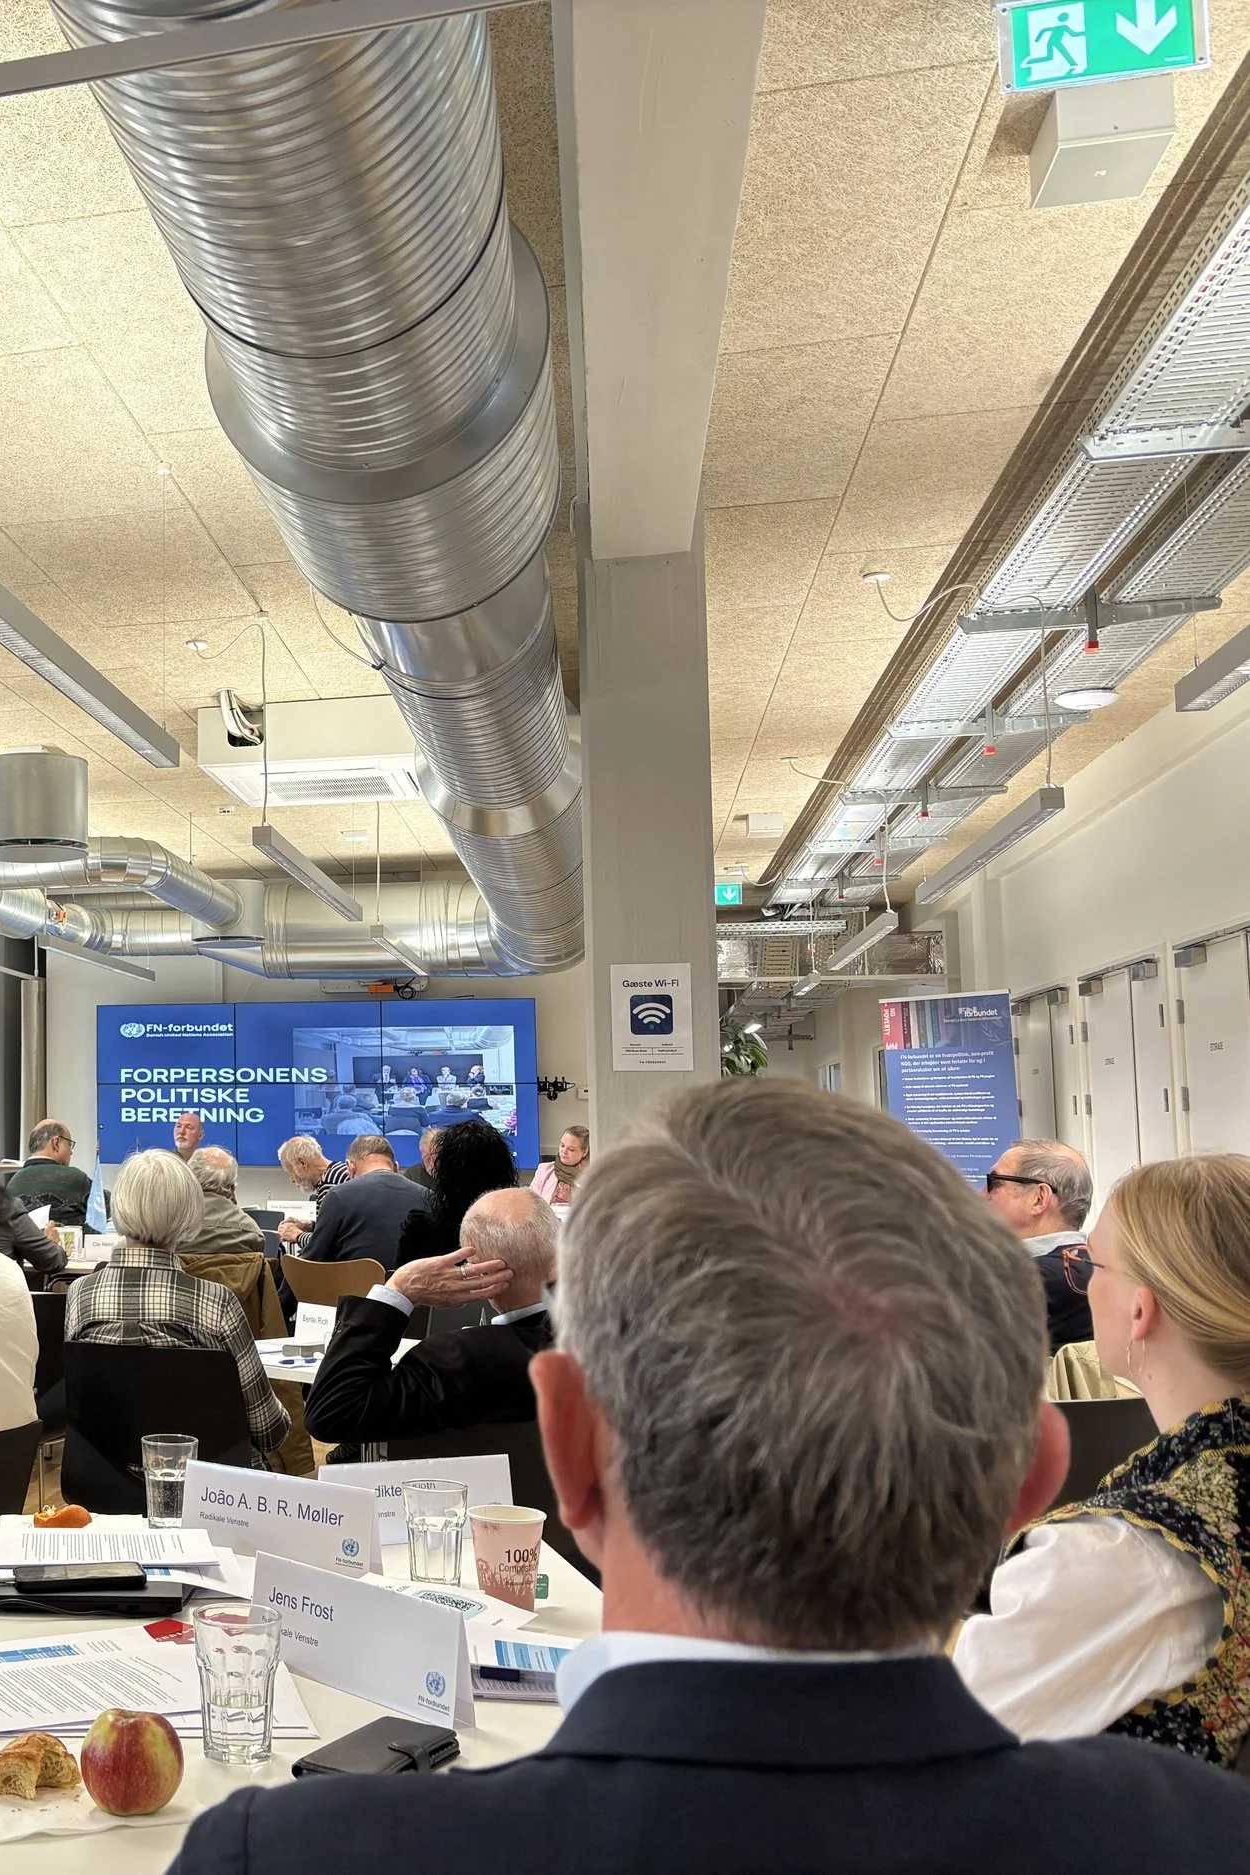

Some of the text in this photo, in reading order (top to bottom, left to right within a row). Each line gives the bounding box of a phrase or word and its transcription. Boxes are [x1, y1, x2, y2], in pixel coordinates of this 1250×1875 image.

[622, 979, 679, 988] Gæste Wi-Fi
[964, 1008, 998, 1017] forbundet
[146, 1023, 234, 1032] FN-forbundet
[120, 1067, 328, 1083] FORPERSONENS
[121, 1088, 250, 1103] POLITISKE
[302, 1314, 317, 1324] Bente
[375, 1485, 402, 1498] dikte
[201, 1487, 344, 1527] João A. B. R. Møller
[200, 1511, 249, 1528] Radikale Venstre
[505, 1547, 538, 1563] 100%
[269, 1586, 334, 1622] Jens Frost
[294, 1630, 319, 1647] Venstre
